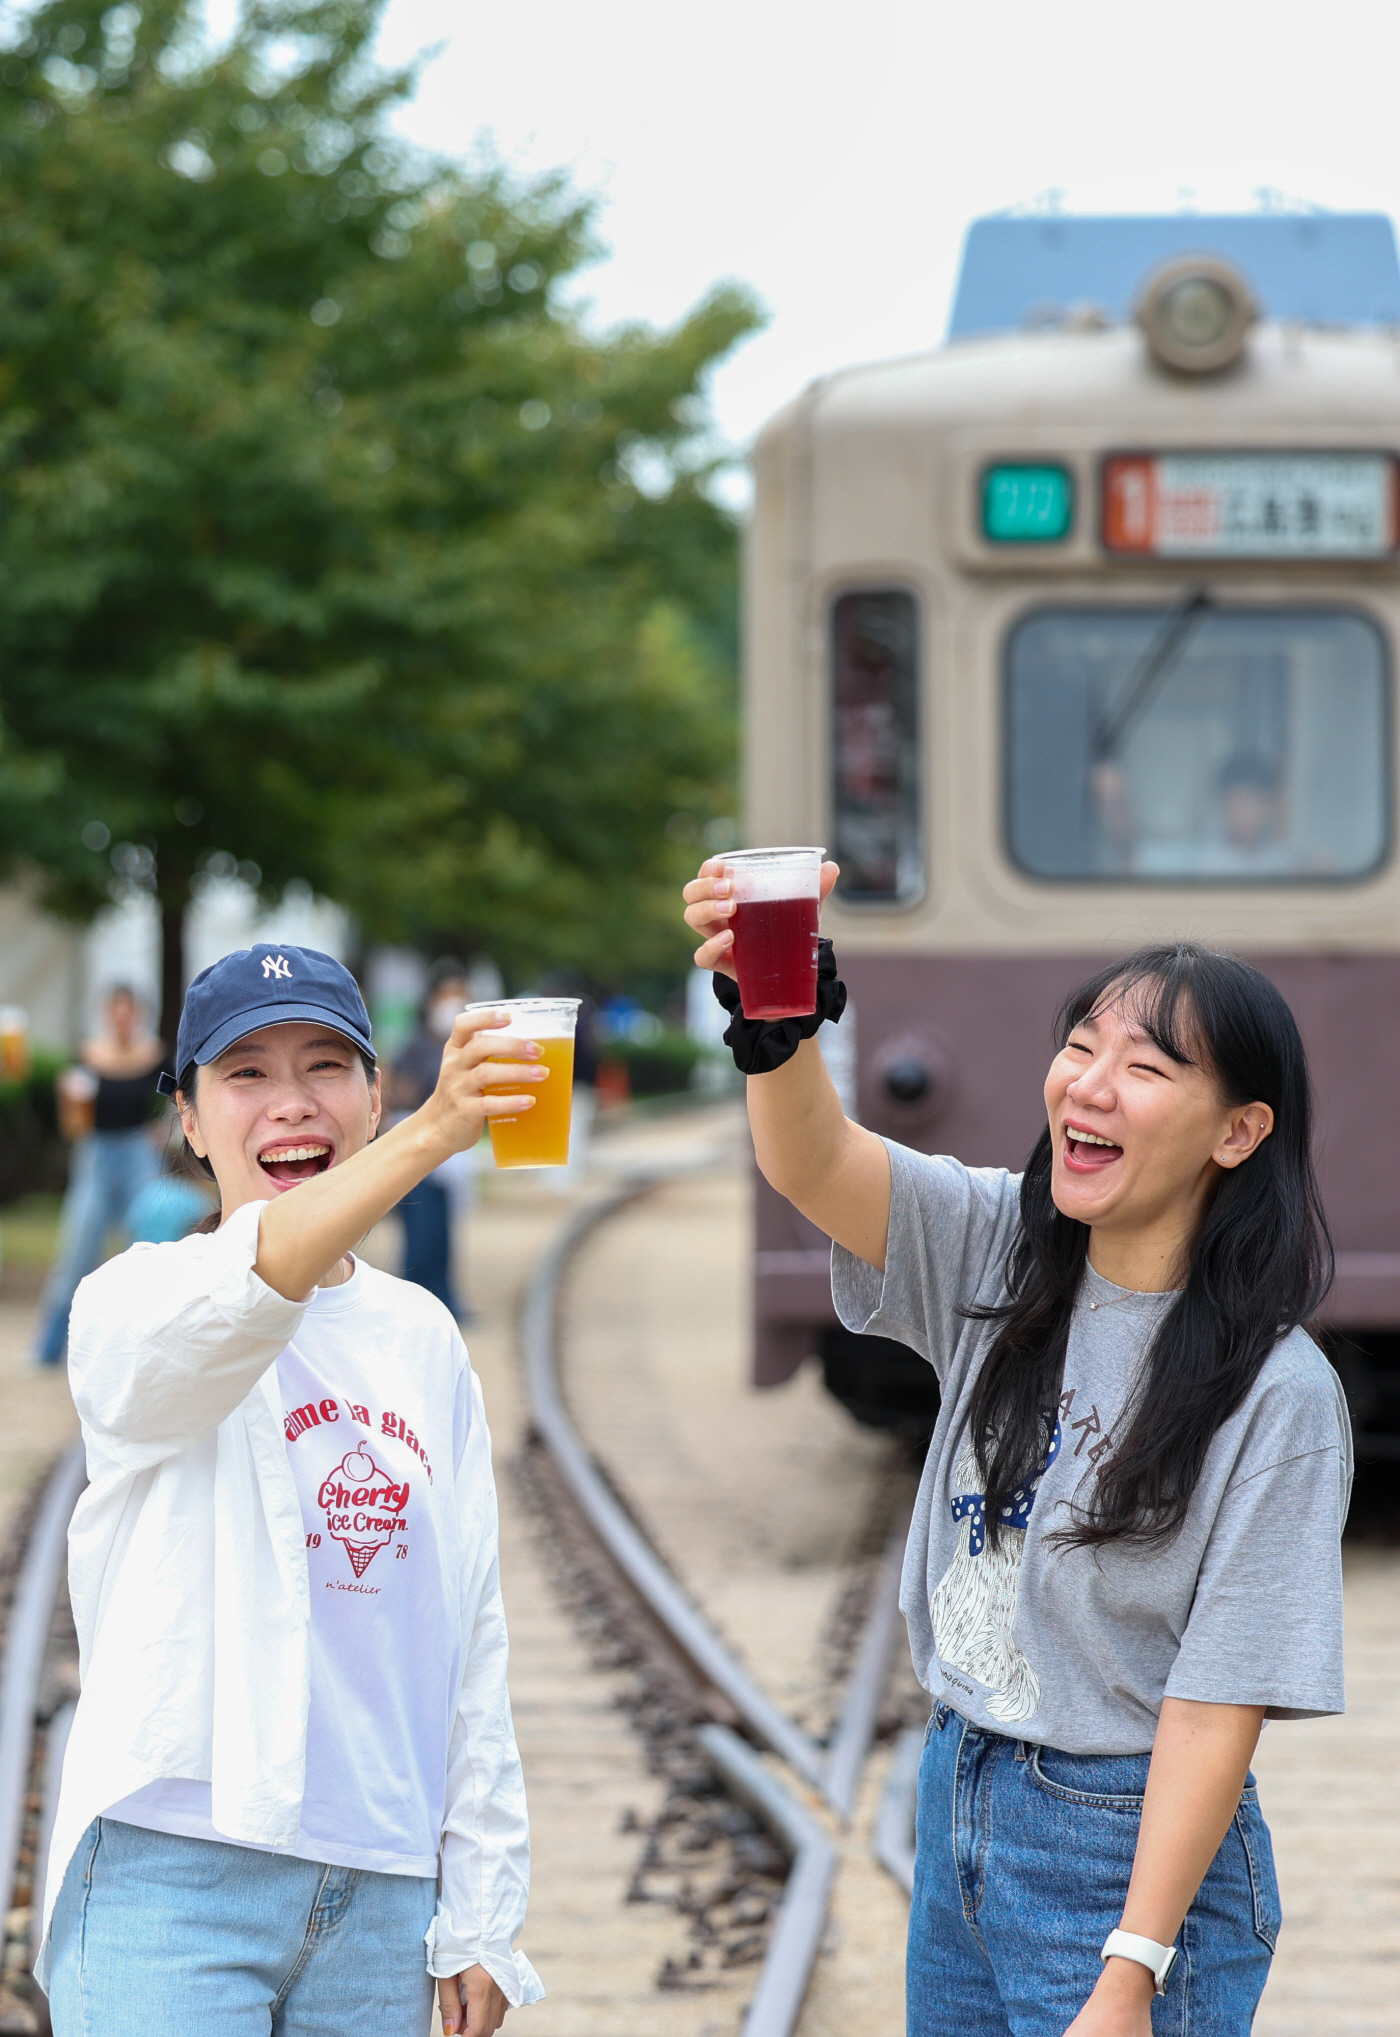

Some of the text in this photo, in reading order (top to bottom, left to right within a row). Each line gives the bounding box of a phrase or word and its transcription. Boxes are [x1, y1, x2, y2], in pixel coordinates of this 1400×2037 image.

[261, 954, 293, 979] NY
[318, 1481, 410, 1512] Cherry
[327, 1508, 352, 1531] ice
[306, 1533, 409, 1560] 19 78
